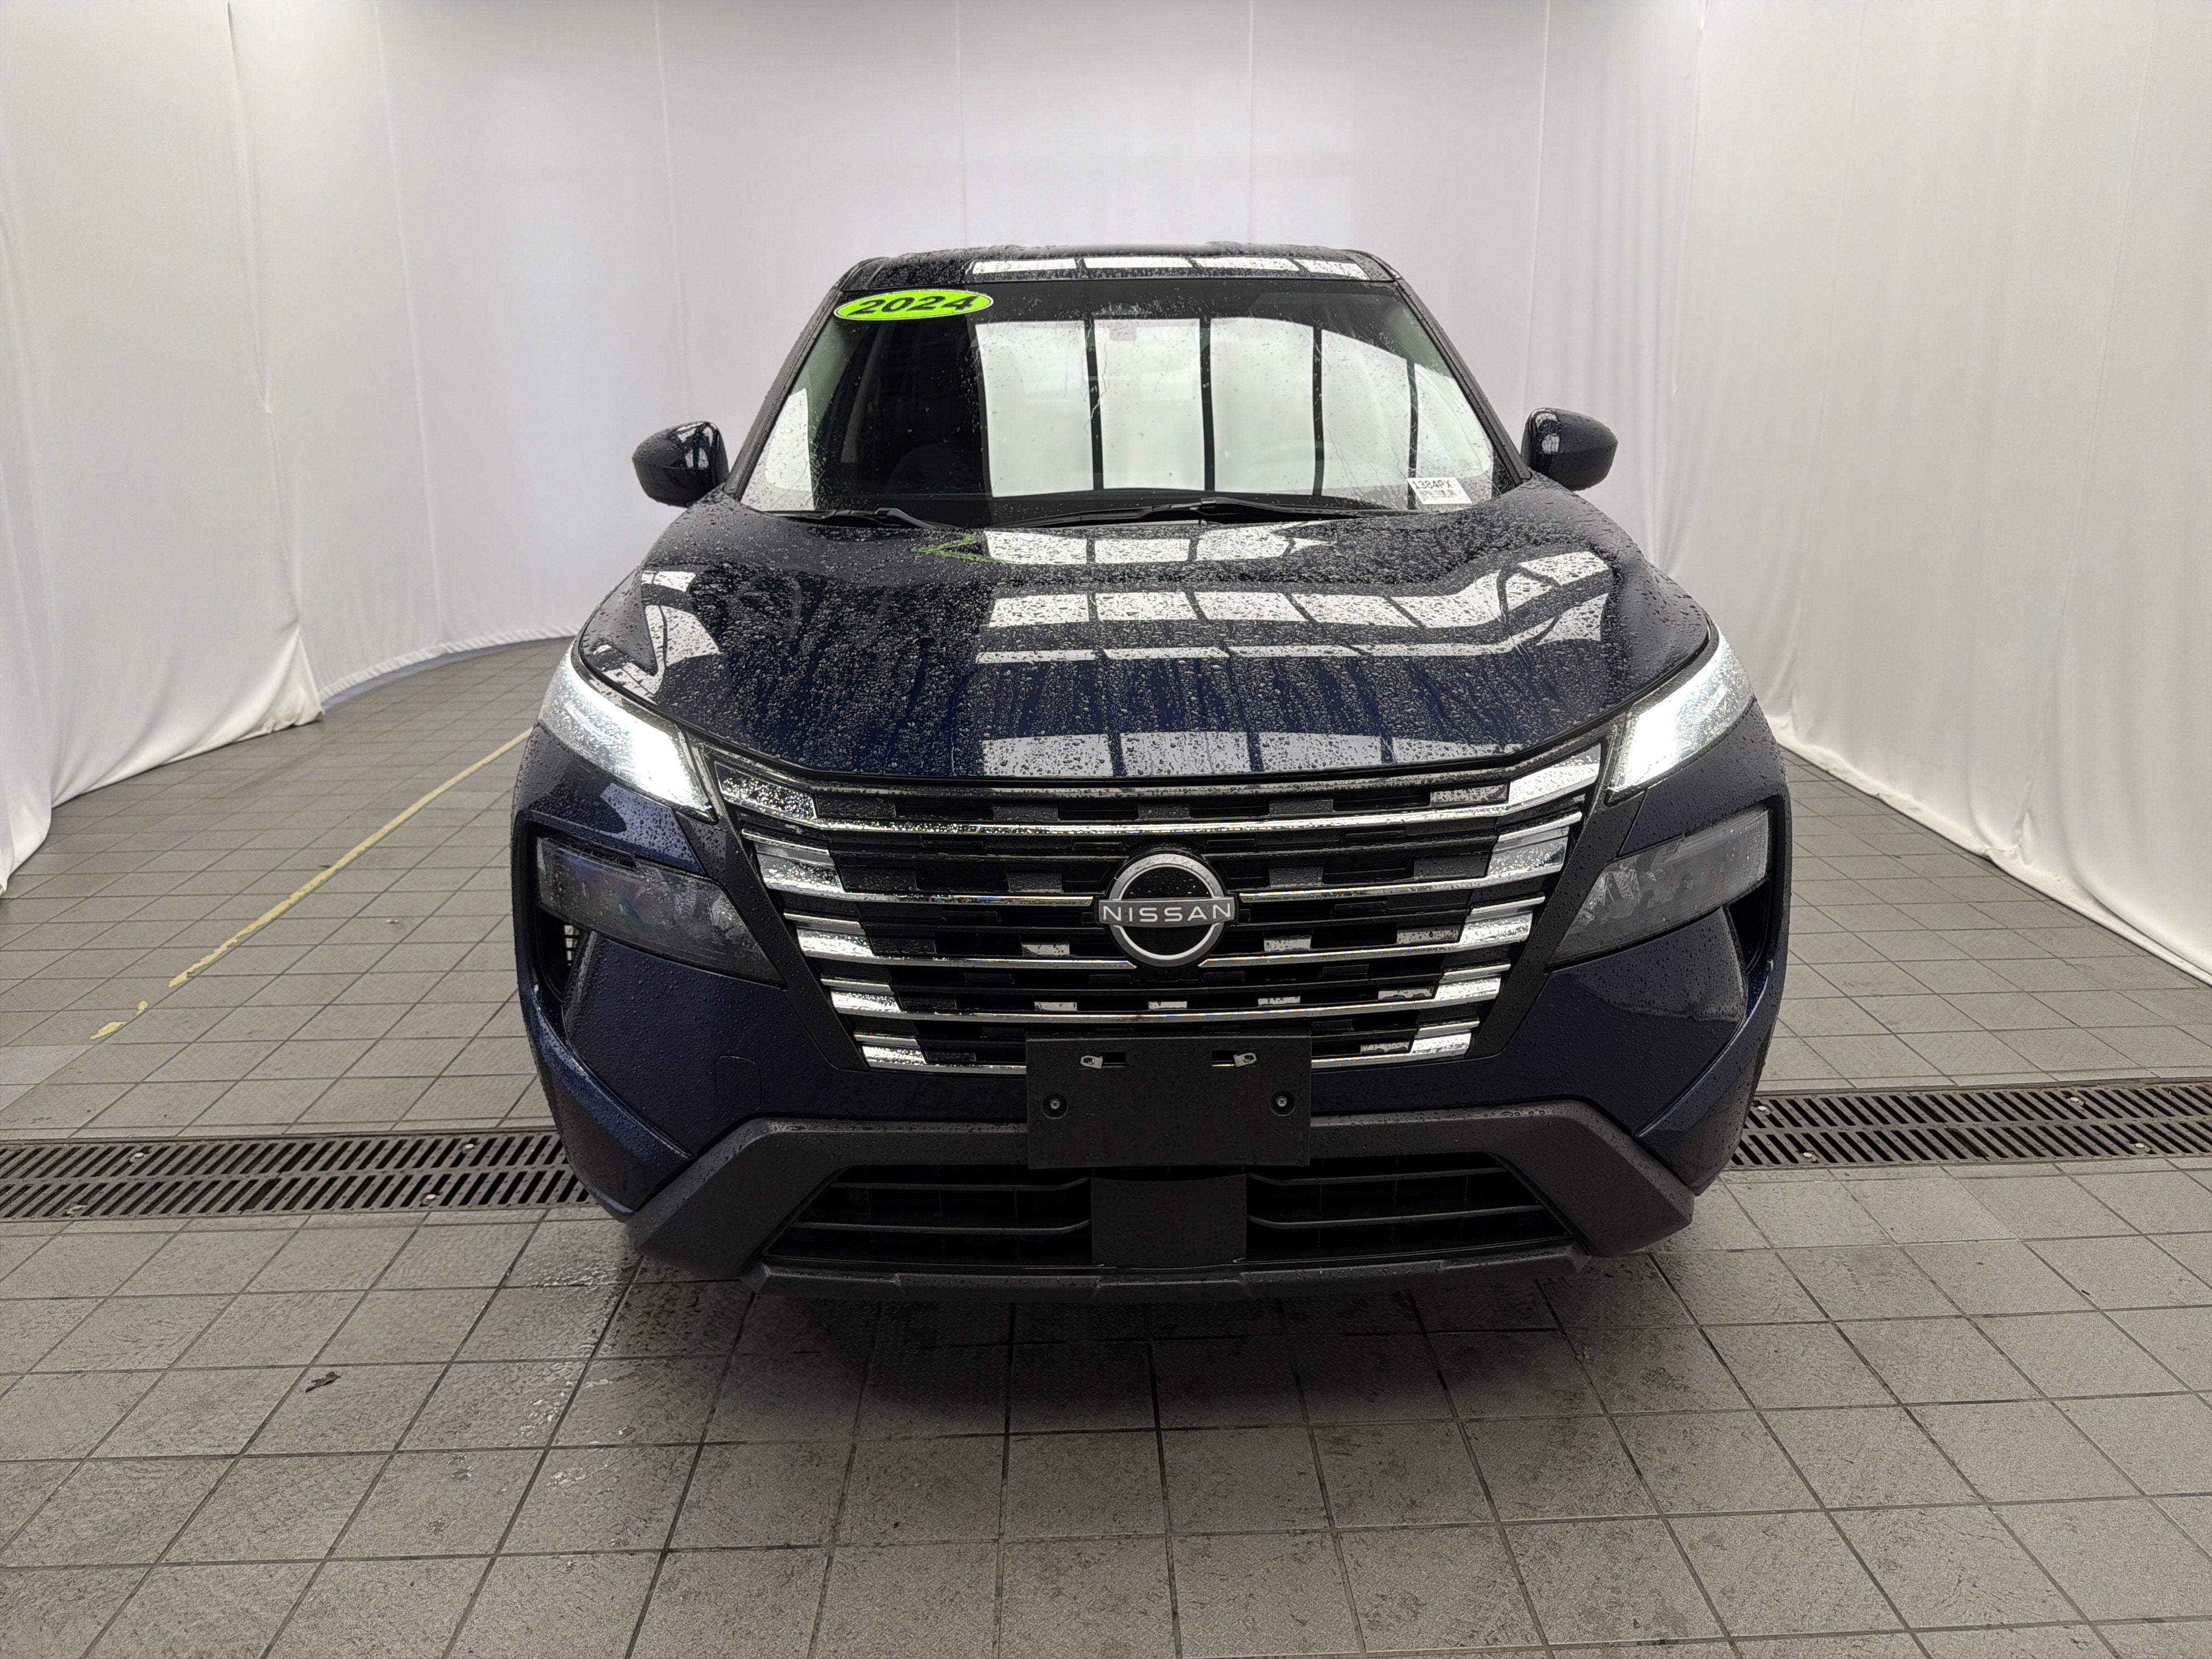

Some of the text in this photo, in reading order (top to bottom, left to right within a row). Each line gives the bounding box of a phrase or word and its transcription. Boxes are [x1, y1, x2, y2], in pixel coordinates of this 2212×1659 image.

[847, 295, 980, 317] 2024
[1412, 479, 1454, 489] 1384PX
[1103, 902, 1231, 922] NISSAN
